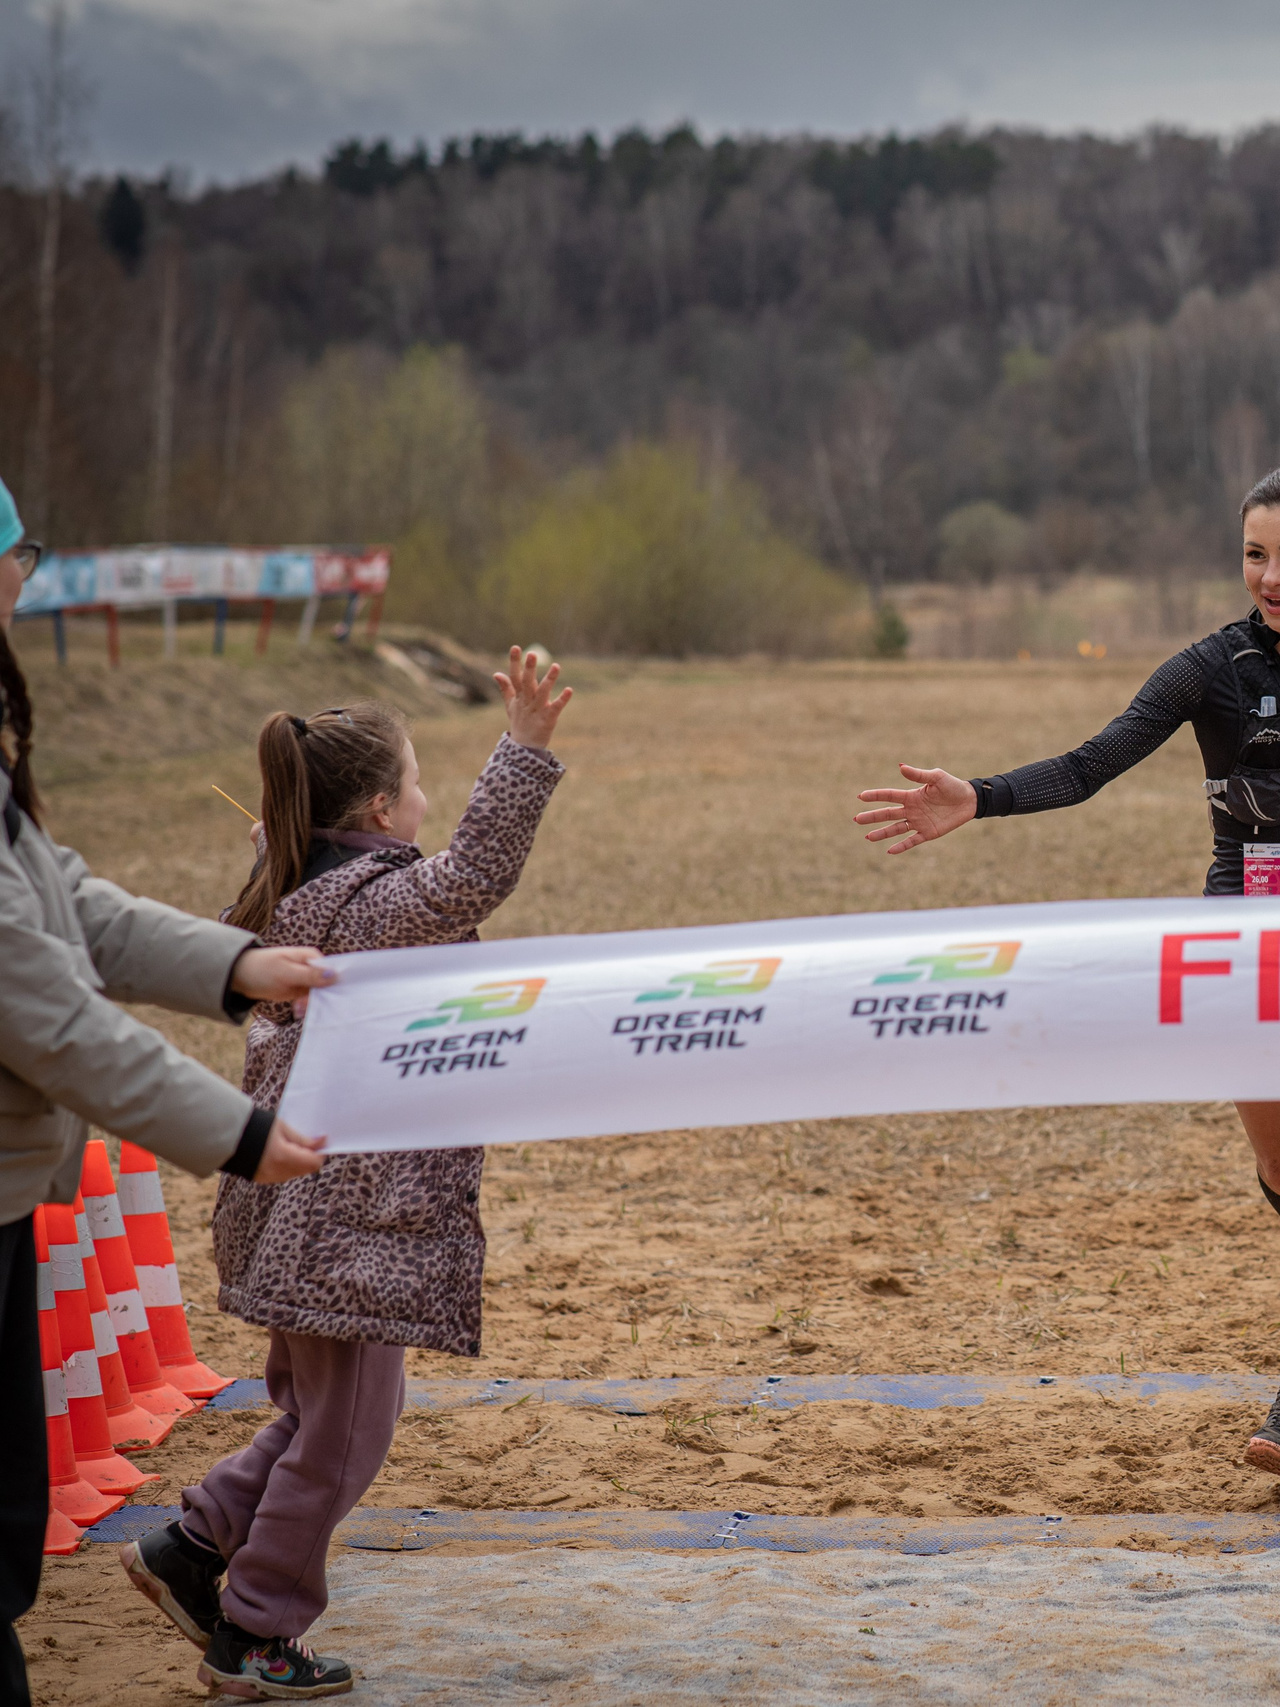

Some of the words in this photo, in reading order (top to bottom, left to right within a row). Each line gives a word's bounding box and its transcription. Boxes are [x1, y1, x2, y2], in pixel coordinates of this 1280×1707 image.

[851, 990, 1006, 1016] DREAM
[612, 1006, 765, 1035] DREAM
[870, 1015, 989, 1039] TRAIL
[382, 1027, 528, 1061] DREAM
[629, 1031, 747, 1056] TRAIL
[398, 1051, 508, 1079] TRAIL
